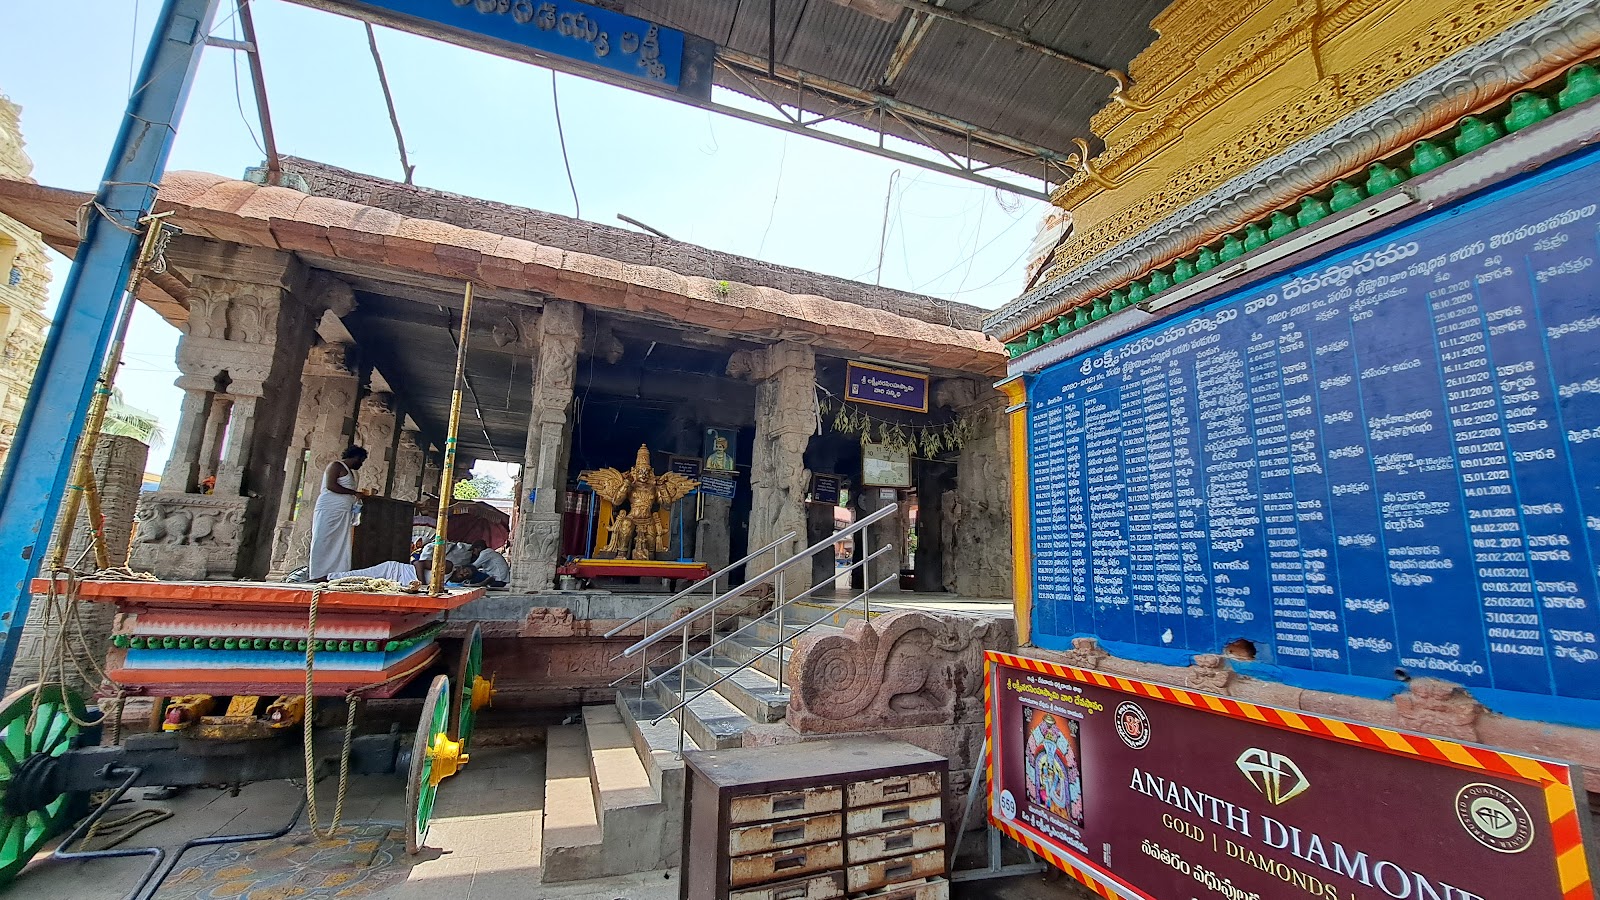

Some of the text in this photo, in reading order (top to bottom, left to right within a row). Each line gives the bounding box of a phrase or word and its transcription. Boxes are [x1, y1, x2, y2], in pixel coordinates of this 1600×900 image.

[1266, 302, 1310, 324] 2020-2021
[1079, 357, 1092, 375] శ్రీ
[1244, 293, 1278, 314] వారి
[1441, 344, 1485, 361] 14.11.2020
[1443, 357, 1486, 373] 16.11.2020
[1445, 371, 1489, 387] 26.11.2020
[1447, 385, 1492, 400] 30.11.2020
[1450, 398, 1495, 414] 11.12.2020
[1452, 412, 1498, 427] 16.12.2020
[1455, 427, 1500, 441] 25.12.2020
[1458, 441, 1504, 454] 08.01.2021
[1460, 455, 1506, 468] 09.01.2021
[1464, 484, 1511, 496] 14.01.2021
[1468, 507, 1515, 518] 24.01.2021
[1470, 522, 1519, 532] 04.02.2021
[1475, 552, 1524, 562] 23.02.2021
[1478, 567, 1528, 577] 04.03.2021
[1482, 582, 1531, 592] 09.03.2021
[1483, 596, 1533, 607] 25.03.2021
[1485, 612, 1538, 624] 31.03.2021
[1488, 627, 1539, 639] 08.04.2021
[1490, 642, 1543, 655] 14.04.2021
[1130, 768, 1253, 838] ANANTH
[1469, 788, 1512, 804] QUALITY
[1001, 796, 1015, 813] 559
[1460, 802, 1486, 840] TRUSTED
[1500, 818, 1528, 848] DESIGNER
[1162, 813, 1205, 843] GOLD
[1225, 840, 1338, 900] DIAMONDS
